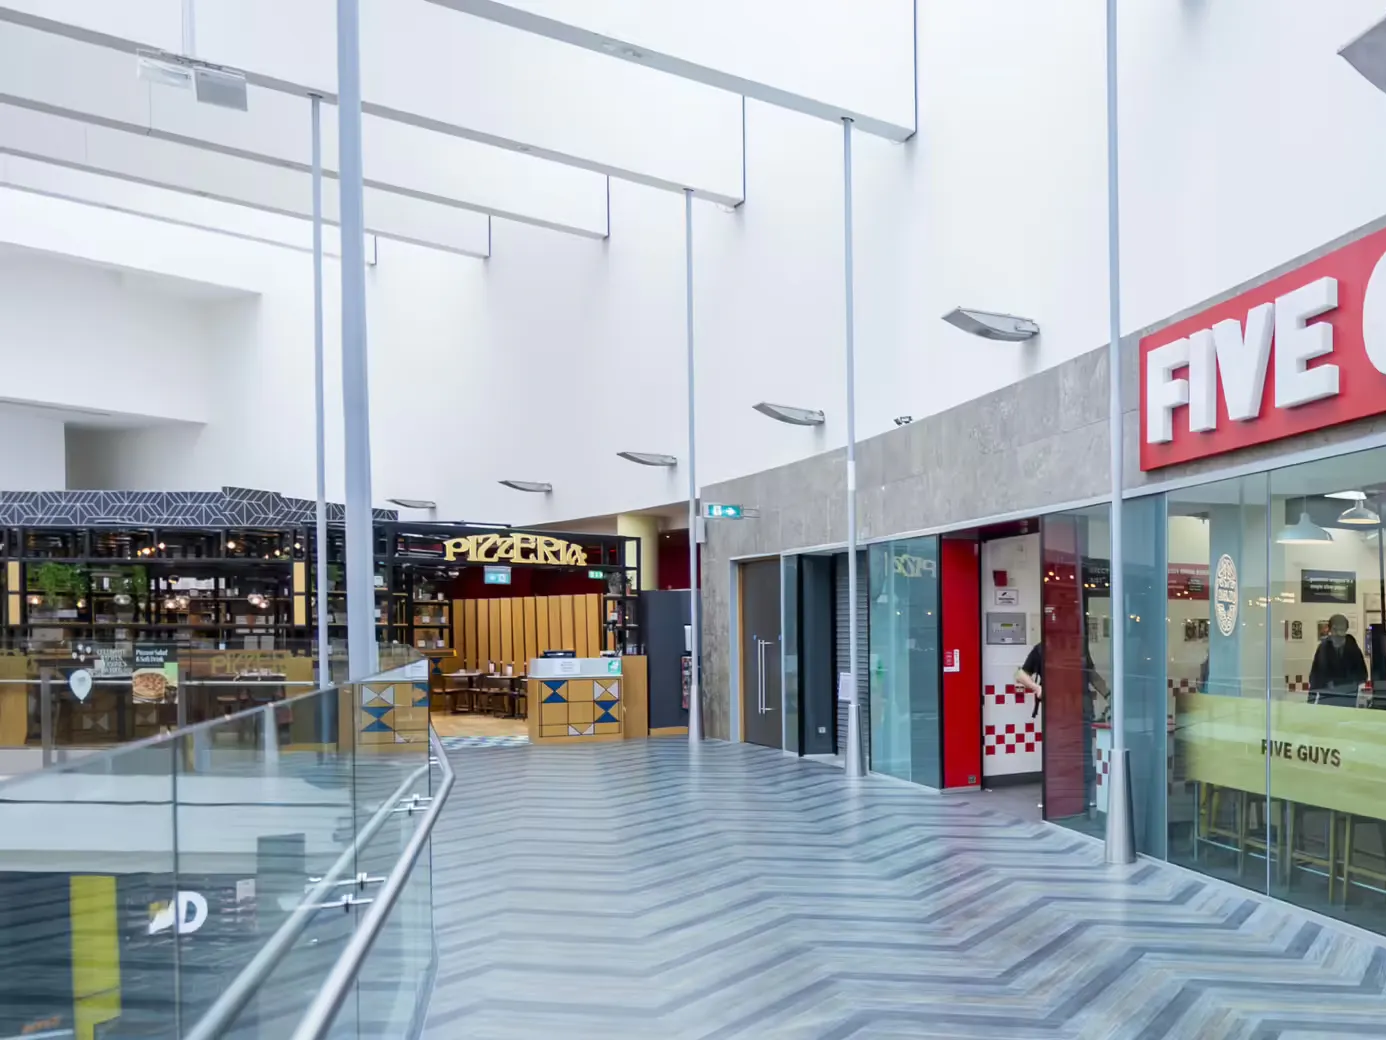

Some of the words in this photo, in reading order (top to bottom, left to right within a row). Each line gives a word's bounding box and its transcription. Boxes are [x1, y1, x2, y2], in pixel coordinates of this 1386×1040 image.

[1146, 276, 1339, 444] FIVE
[443, 533, 588, 566] PIZZERIA
[1261, 738, 1293, 760] FIVE
[1297, 744, 1342, 768] GUYS
